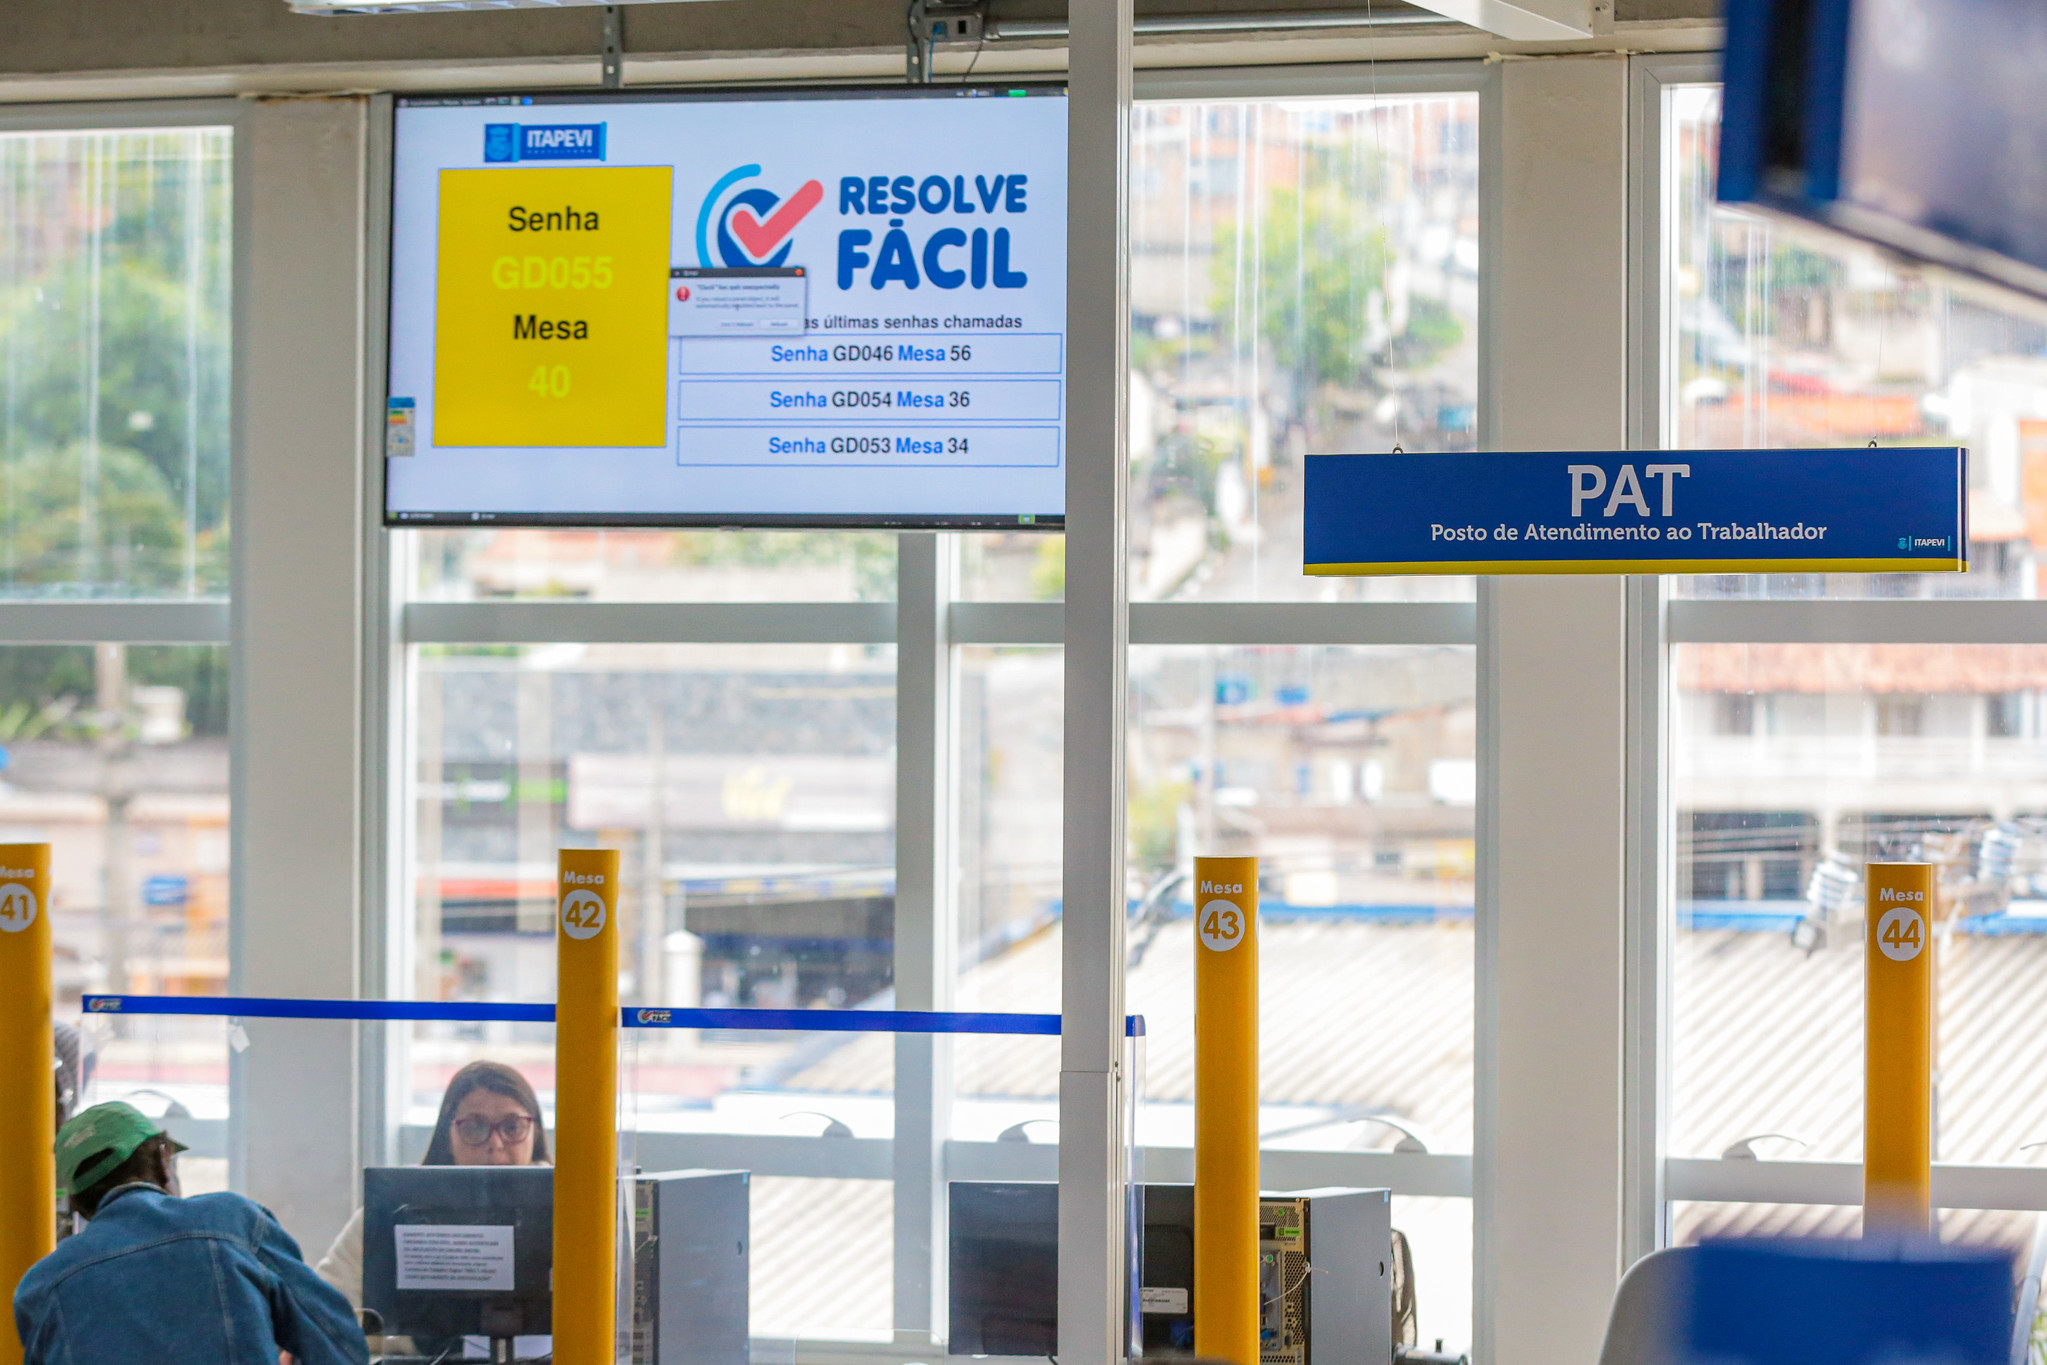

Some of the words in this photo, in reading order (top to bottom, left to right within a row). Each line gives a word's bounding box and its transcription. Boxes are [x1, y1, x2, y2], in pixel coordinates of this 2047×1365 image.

[526, 129, 593, 147] ITAPEVI
[839, 174, 1028, 214] RESOLVE
[508, 205, 599, 232] Senha
[837, 218, 1028, 290] FÁCIL
[491, 256, 615, 291] GD055
[513, 314, 588, 340] Mesa
[823, 315, 879, 329] últimas
[884, 315, 939, 329] senhas
[943, 314, 1022, 329] chamadas
[771, 345, 828, 362] Senha
[832, 344, 894, 362] GD046
[898, 344, 946, 362] Mesa
[950, 344, 972, 362] 56
[528, 365, 572, 398] 40
[770, 391, 827, 408] Senha
[831, 390, 892, 408] GD054
[897, 390, 944, 408] Mesa
[949, 390, 970, 408] 36
[769, 436, 826, 454] Senha
[830, 436, 891, 454] GD053
[896, 437, 943, 454] Mesa
[947, 437, 969, 454] 34
[1567, 463, 1691, 517] PAT
[1430, 524, 1488, 542] Posto
[1493, 524, 1519, 541] de
[1524, 523, 1661, 541] Atendimento
[1666, 527, 1692, 541] ao
[1697, 522, 1828, 541] Trabalhador
[1914, 538, 1945, 547] ITAPEVI
[563, 870, 605, 885] Mesa
[1200, 880, 1243, 894] Mesa
[0, 894, 29, 921] 41
[1879, 887, 1925, 902] Mesa
[565, 900, 600, 928] 42
[1203, 910, 1240, 940] 43
[1882, 919, 1921, 949] 44
